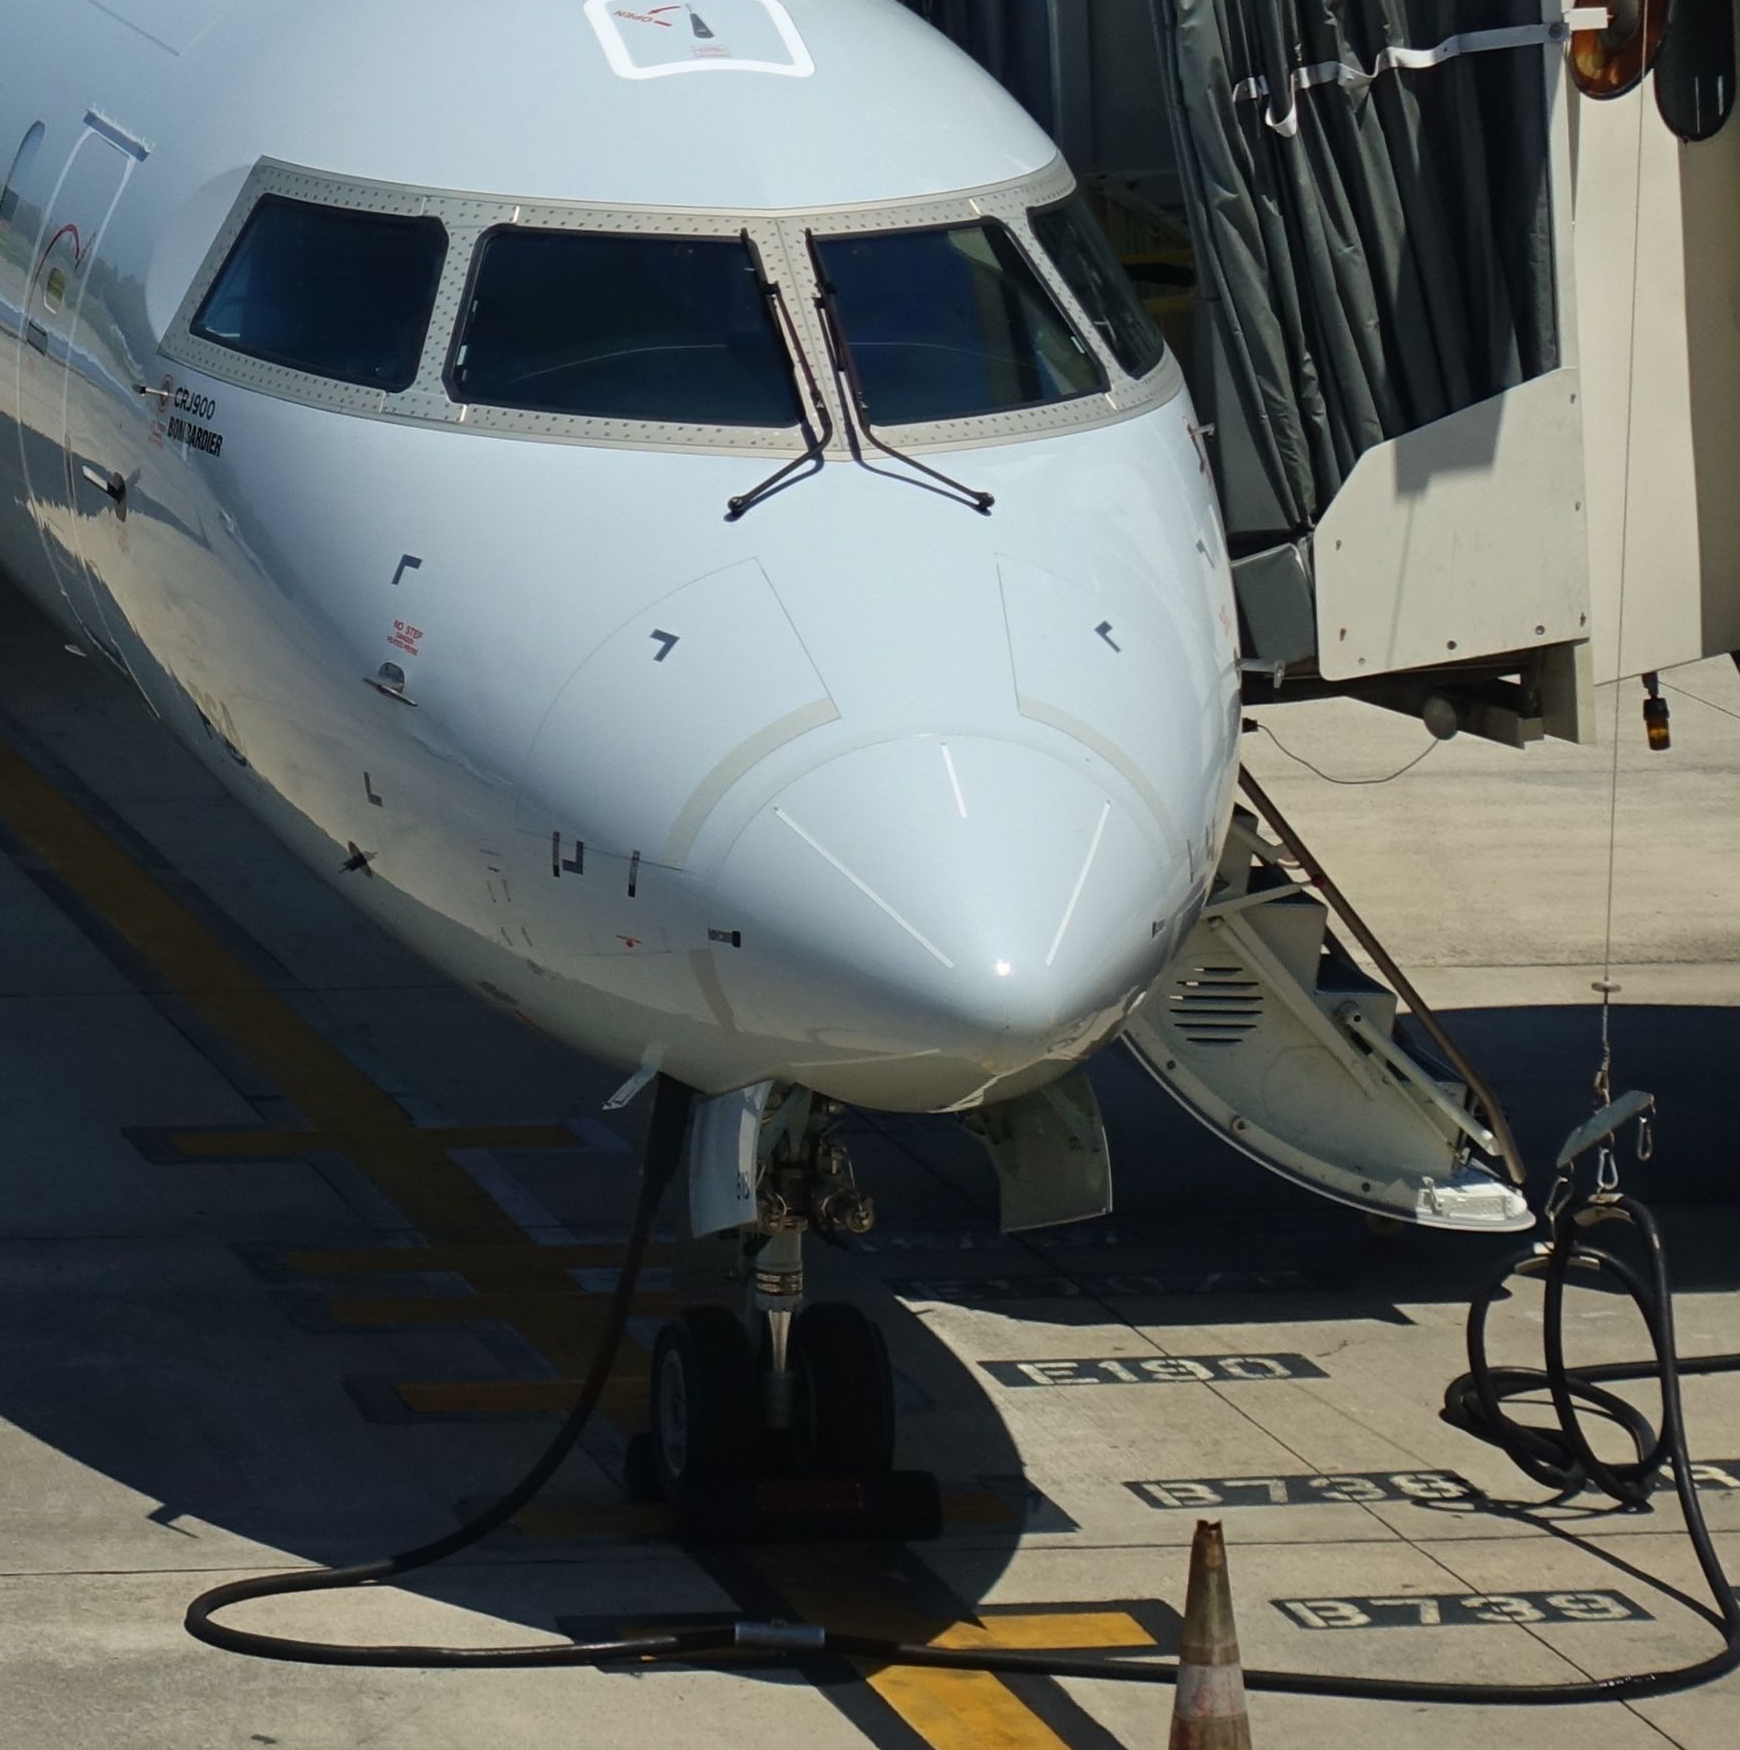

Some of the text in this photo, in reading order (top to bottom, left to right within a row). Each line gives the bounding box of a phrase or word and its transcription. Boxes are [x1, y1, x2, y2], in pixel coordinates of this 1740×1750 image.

[613, 10, 653, 23] OPEN
[174, 387, 216, 420] CRJ900
[167, 416, 224, 457] BOMBARDIER
[1016, 1357, 1292, 1385] E190
[1142, 1474, 1470, 1508] B738
[1283, 1593, 1632, 1628] B739
